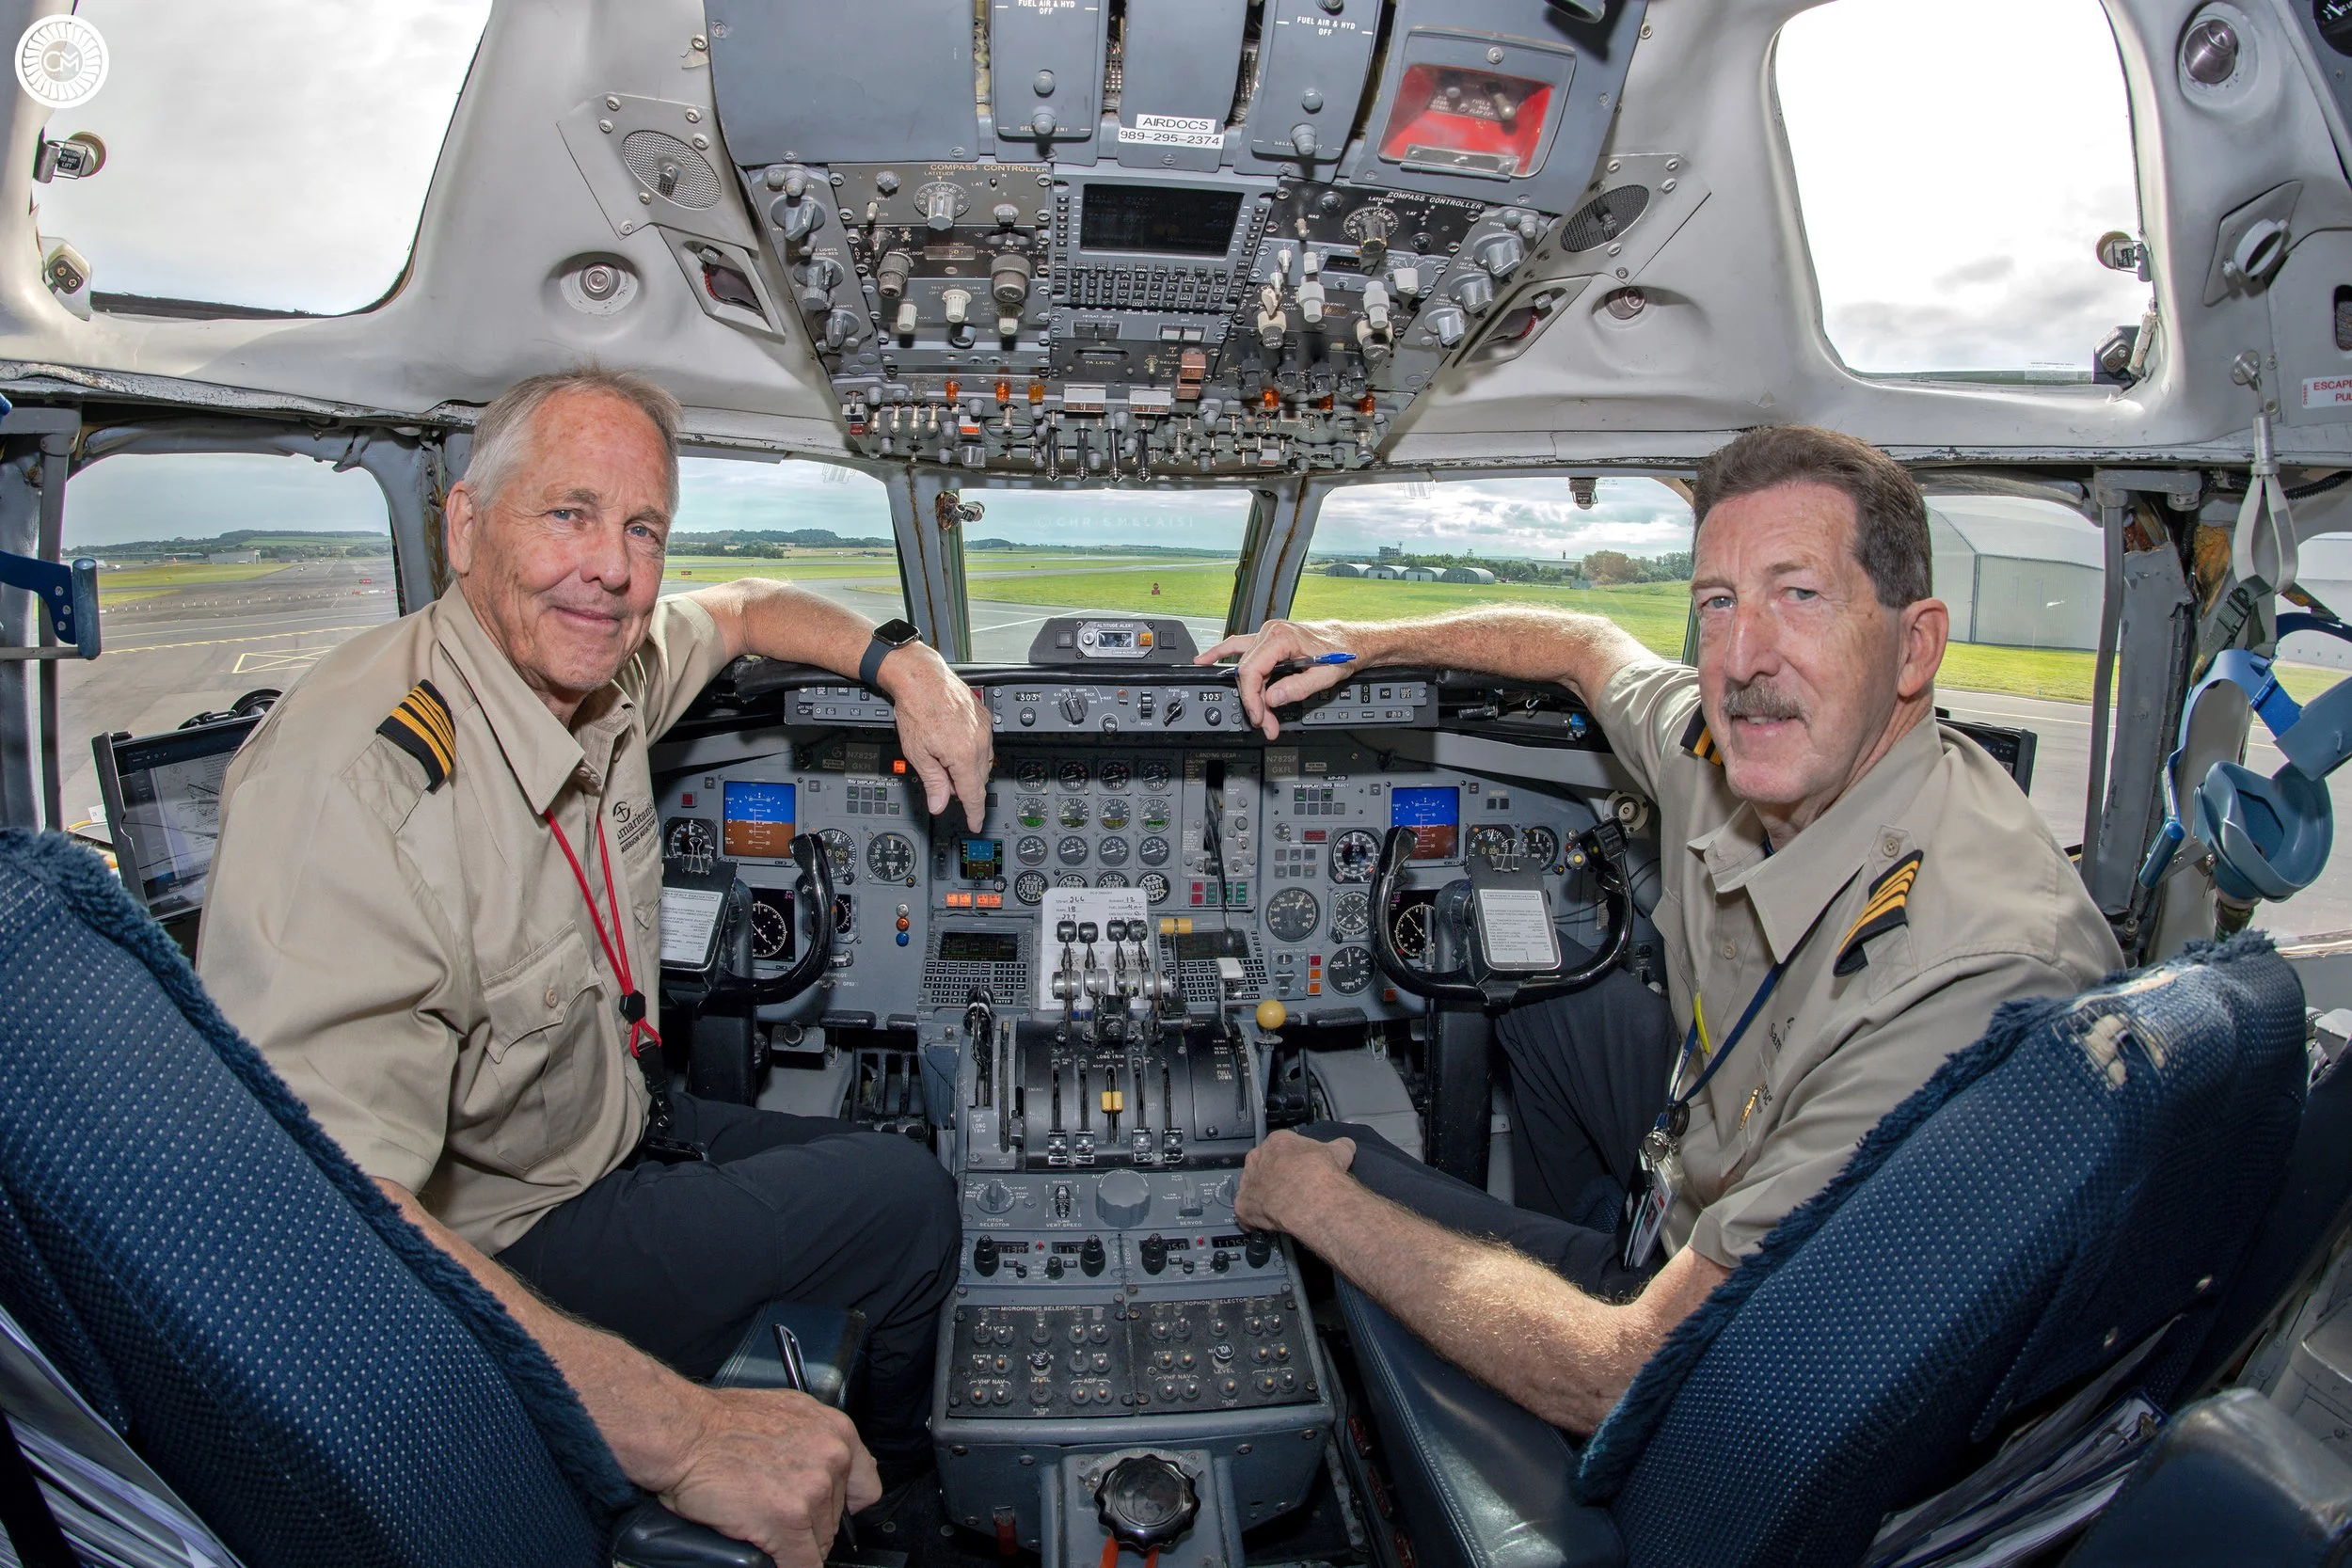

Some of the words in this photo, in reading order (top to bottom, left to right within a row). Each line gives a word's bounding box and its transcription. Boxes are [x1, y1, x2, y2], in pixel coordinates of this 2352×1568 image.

[1297, 16, 1315, 25] FUEL
[1341, 22, 1356, 30] HYD
[1142, 118, 1209, 130] AIRDOCS
[1120, 130, 1220, 146] 989-295-2374
[1368, 196, 1395, 204] LATITUDE
[1388, 191, 1426, 202] COMPASS
[1429, 197, 1483, 211] CONTROLLER
[1209, 710, 1219, 721] CRS
